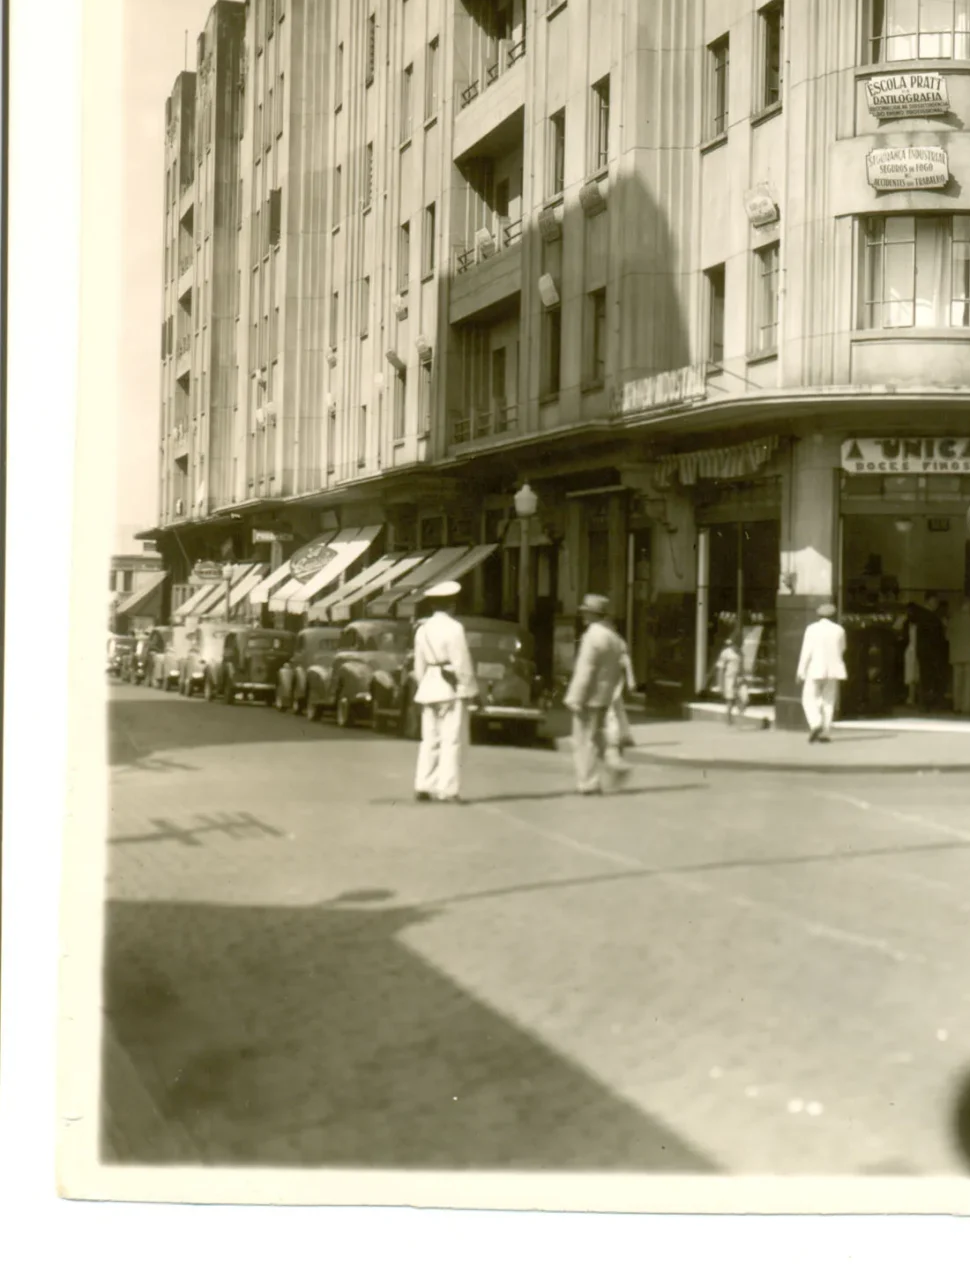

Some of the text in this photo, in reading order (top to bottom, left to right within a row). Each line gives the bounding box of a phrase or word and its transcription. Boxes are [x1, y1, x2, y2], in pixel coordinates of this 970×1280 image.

[867, 75, 941, 96] ESCOLA PRATT
[873, 92, 943, 106] DATILOGRAFIA
[880, 164, 907, 174] SEGUROS
[916, 163, 934, 172] FOGO
[845, 438, 864, 461] A
[856, 461, 910, 471] DOCES
